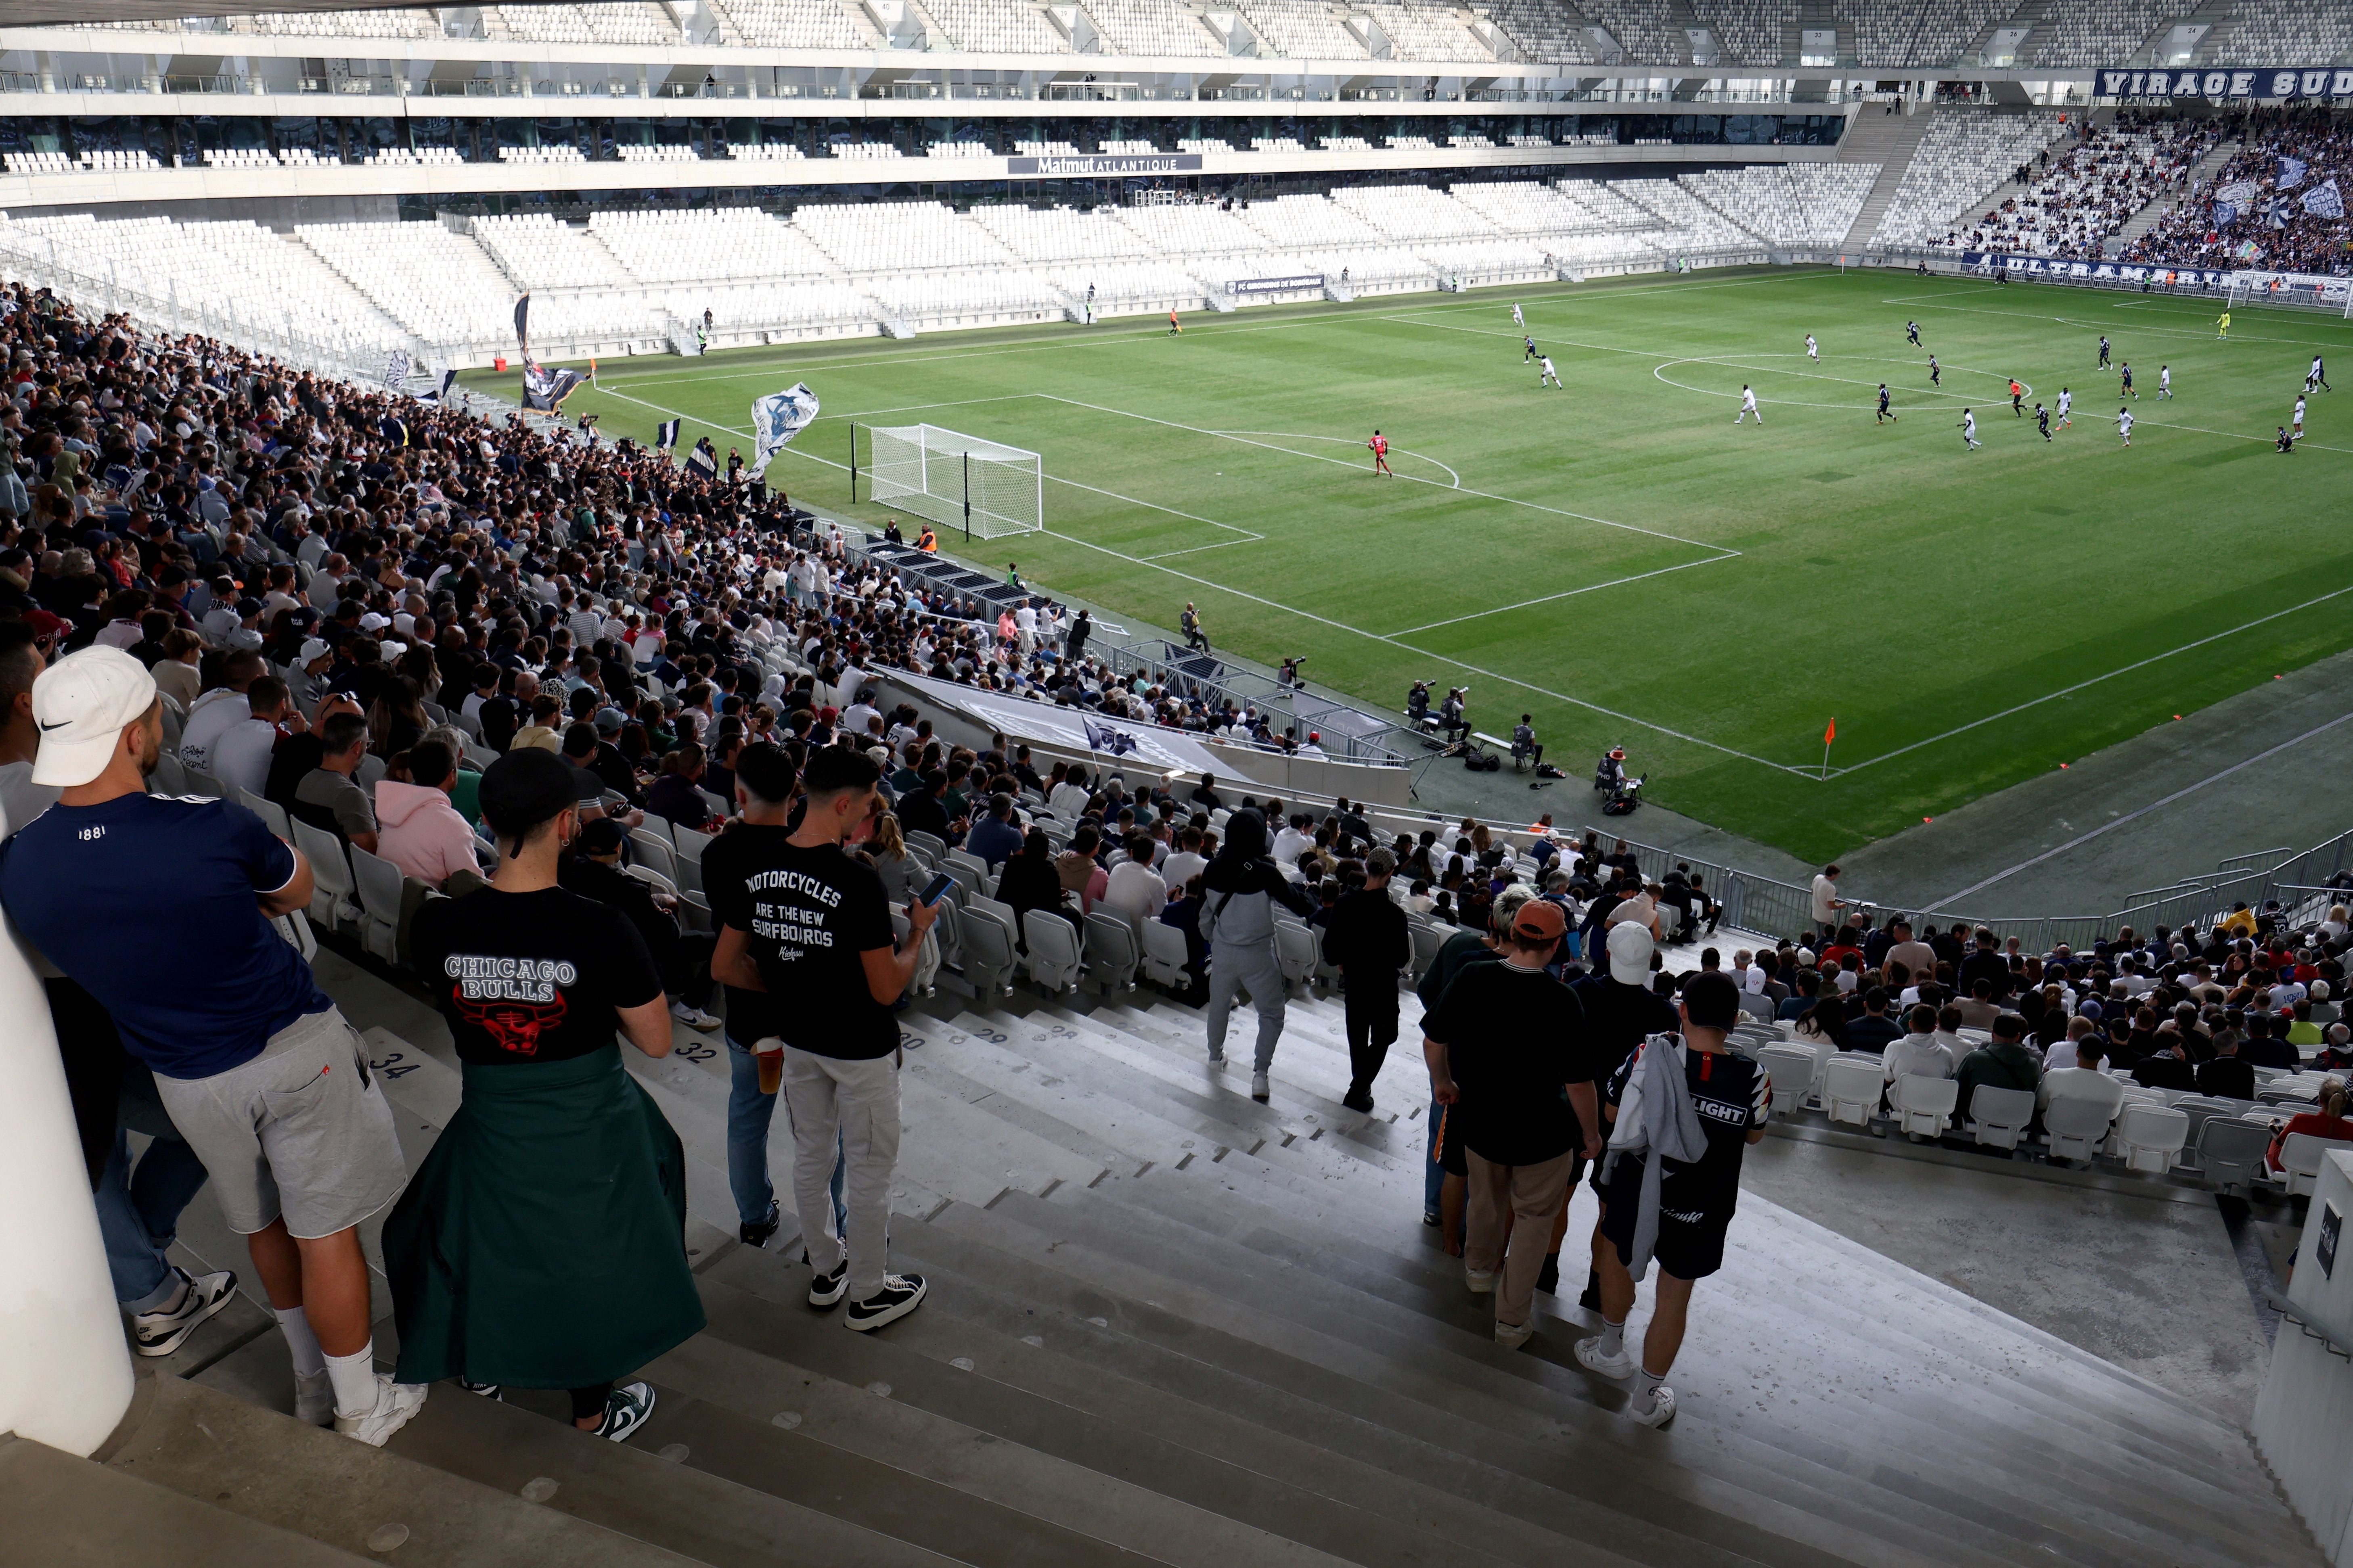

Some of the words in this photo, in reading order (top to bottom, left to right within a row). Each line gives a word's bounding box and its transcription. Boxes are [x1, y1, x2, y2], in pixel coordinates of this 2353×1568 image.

[2103, 72, 2255, 97] VIRAGE
[2272, 72, 2353, 98] SUD
[1038, 158, 1095, 174] Matmut
[1097, 160, 1177, 172] ATLANTIQUE
[1247, 281, 1280, 290] GIRONDINS
[1290, 278, 1321, 287] BORDEAUX
[1597, 772, 1610, 780] PHO
[79, 826, 105, 840] 1881
[745, 870, 841, 907] MOTORCYCLES
[756, 902, 773, 918] ARE
[777, 905, 798, 921] THE
[800, 909, 825, 926] NEW
[752, 919, 833, 947] SURFBOARDS
[445, 956, 575, 984] CHICAGO
[462, 980, 554, 1002] BULLS
[973, 1028, 1007, 1043] 29
[675, 1042, 717, 1064] 32
[368, 1053, 421, 1079] 34
[1694, 1098, 1744, 1124] LIGHT
